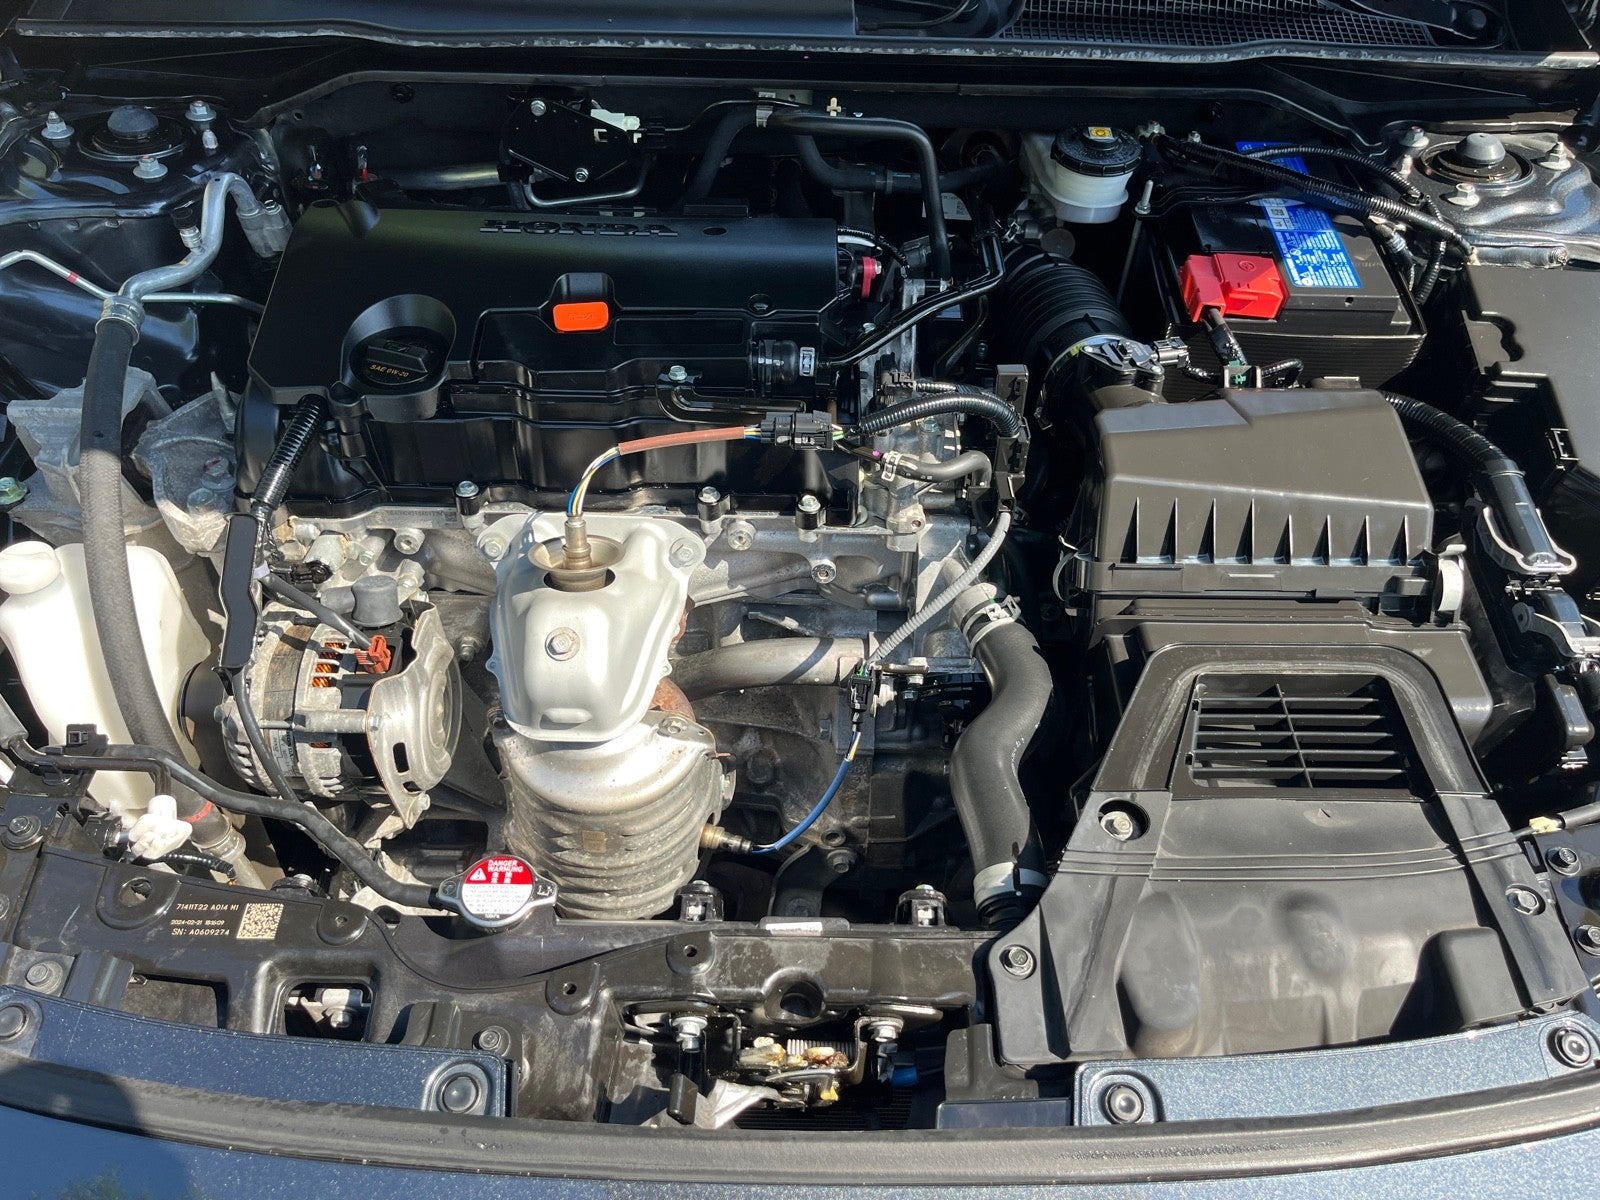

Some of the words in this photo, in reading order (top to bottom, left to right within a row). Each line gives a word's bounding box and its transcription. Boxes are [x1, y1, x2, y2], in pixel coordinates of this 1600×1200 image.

[479, 219, 678, 236] HONDA
[369, 364, 387, 373] SAE
[386, 368, 410, 378] 0W-20
[176, 903, 209, 911] 71411T22
[210, 903, 228, 911] A014
[171, 928, 188, 936] SN:
